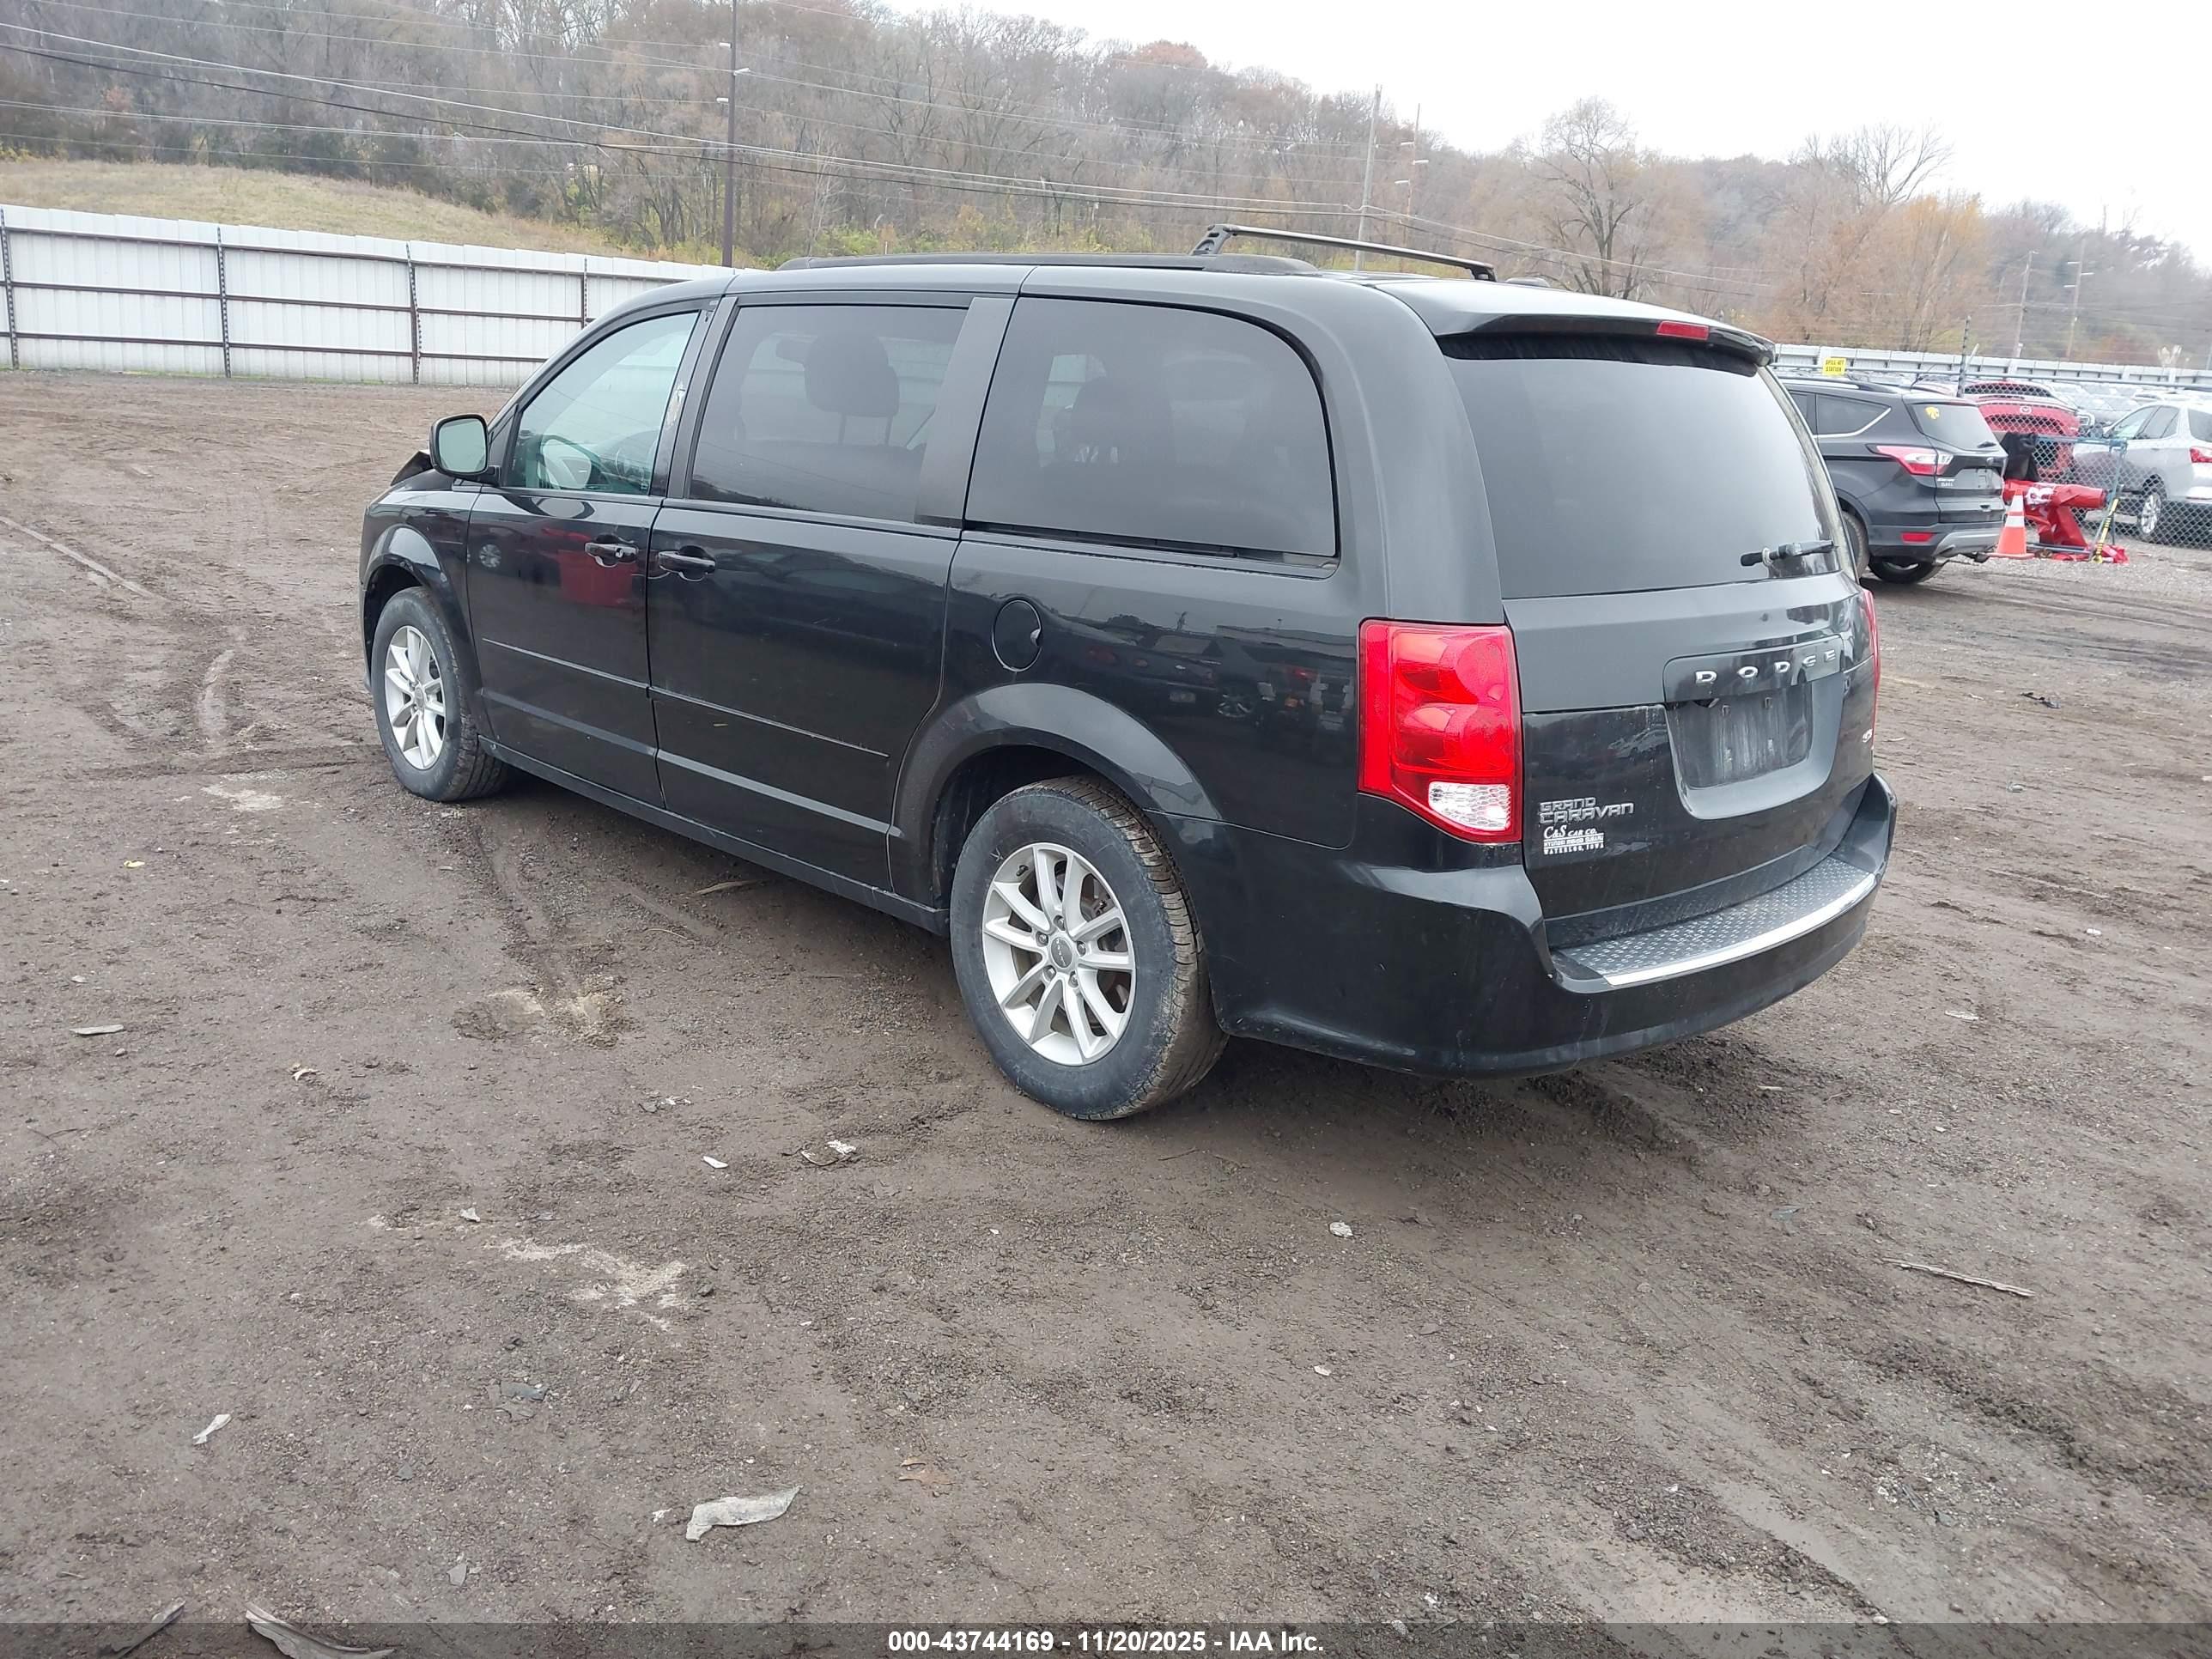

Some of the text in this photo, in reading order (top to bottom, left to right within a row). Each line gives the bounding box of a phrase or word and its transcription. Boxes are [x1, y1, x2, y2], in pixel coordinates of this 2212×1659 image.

[1695, 649, 1836, 684] DODGE
[1540, 797, 1596, 812] GRAND
[1540, 803, 1634, 824] CARAVAN
[1543, 824, 1567, 839] C&S
